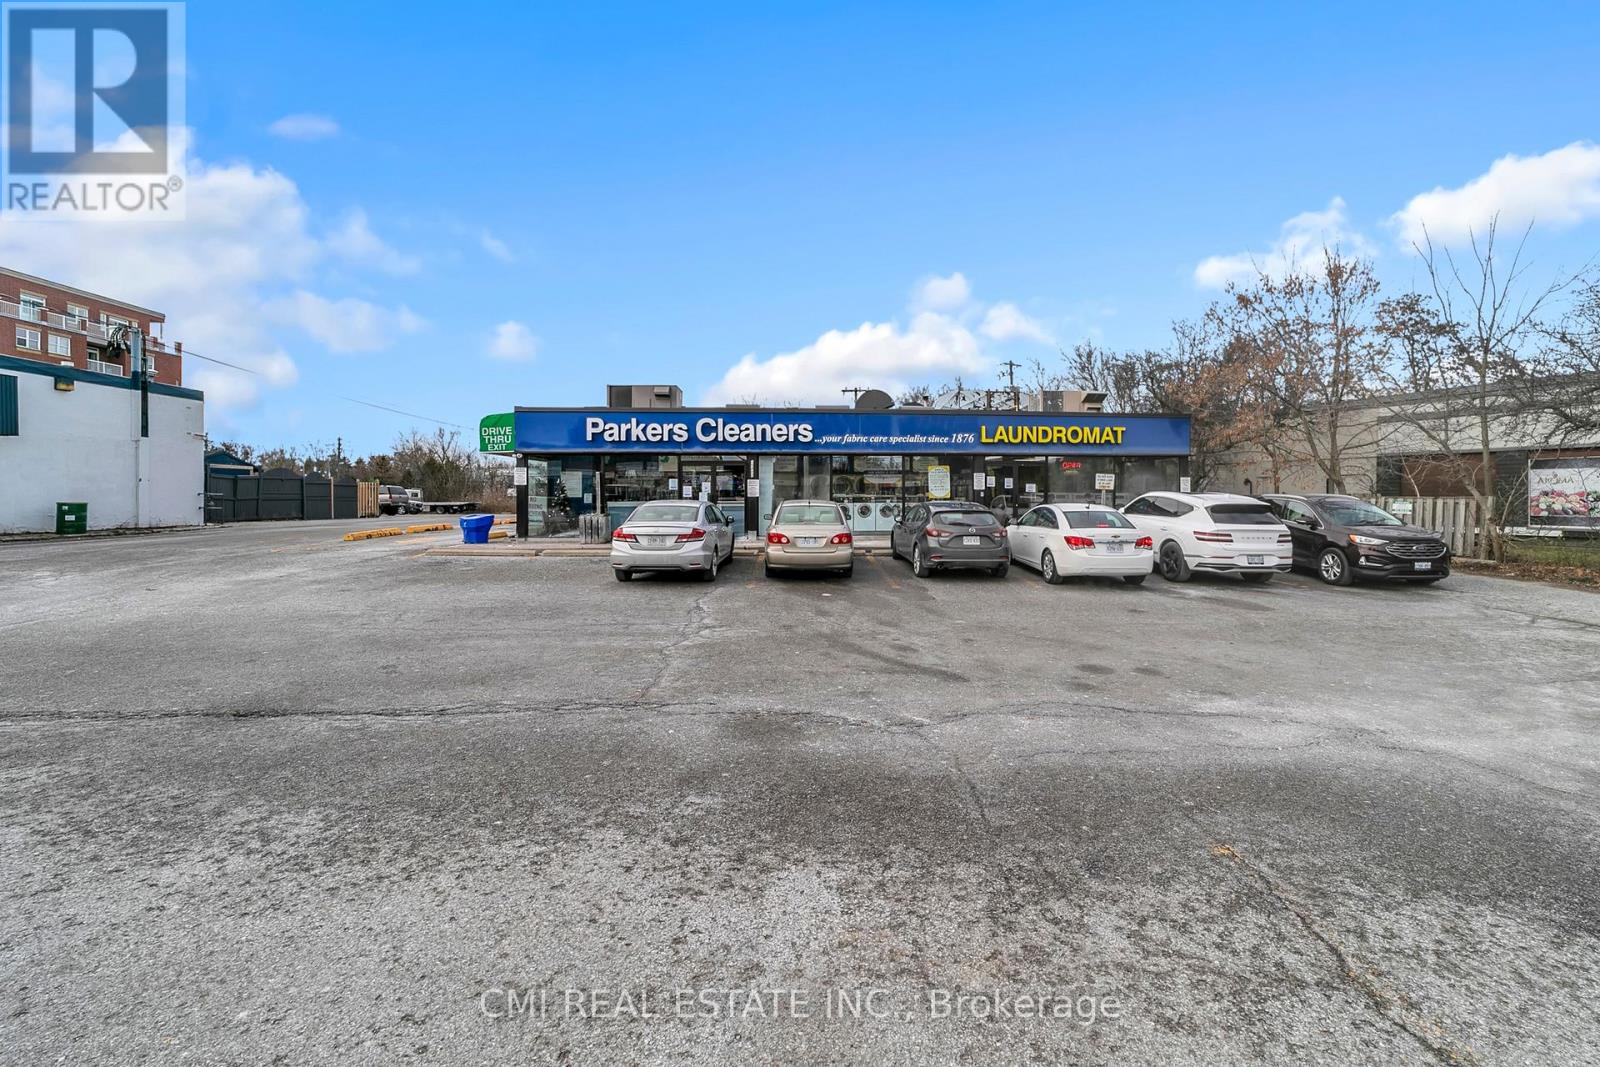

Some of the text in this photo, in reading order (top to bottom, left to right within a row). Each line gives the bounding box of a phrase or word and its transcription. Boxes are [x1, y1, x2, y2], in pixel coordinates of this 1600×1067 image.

[481, 426, 513, 436] DRIVE
[586, 417, 814, 442] Parkers Cleaners
[980, 425, 1127, 445] LAUNDROMAT
[483, 435, 512, 443] THRU
[841, 434, 868, 445] fabric
[888, 433, 928, 444] specialist
[927, 434, 949, 443] since
[950, 433, 975, 444] 1876
[488, 443, 507, 451] EXIT
